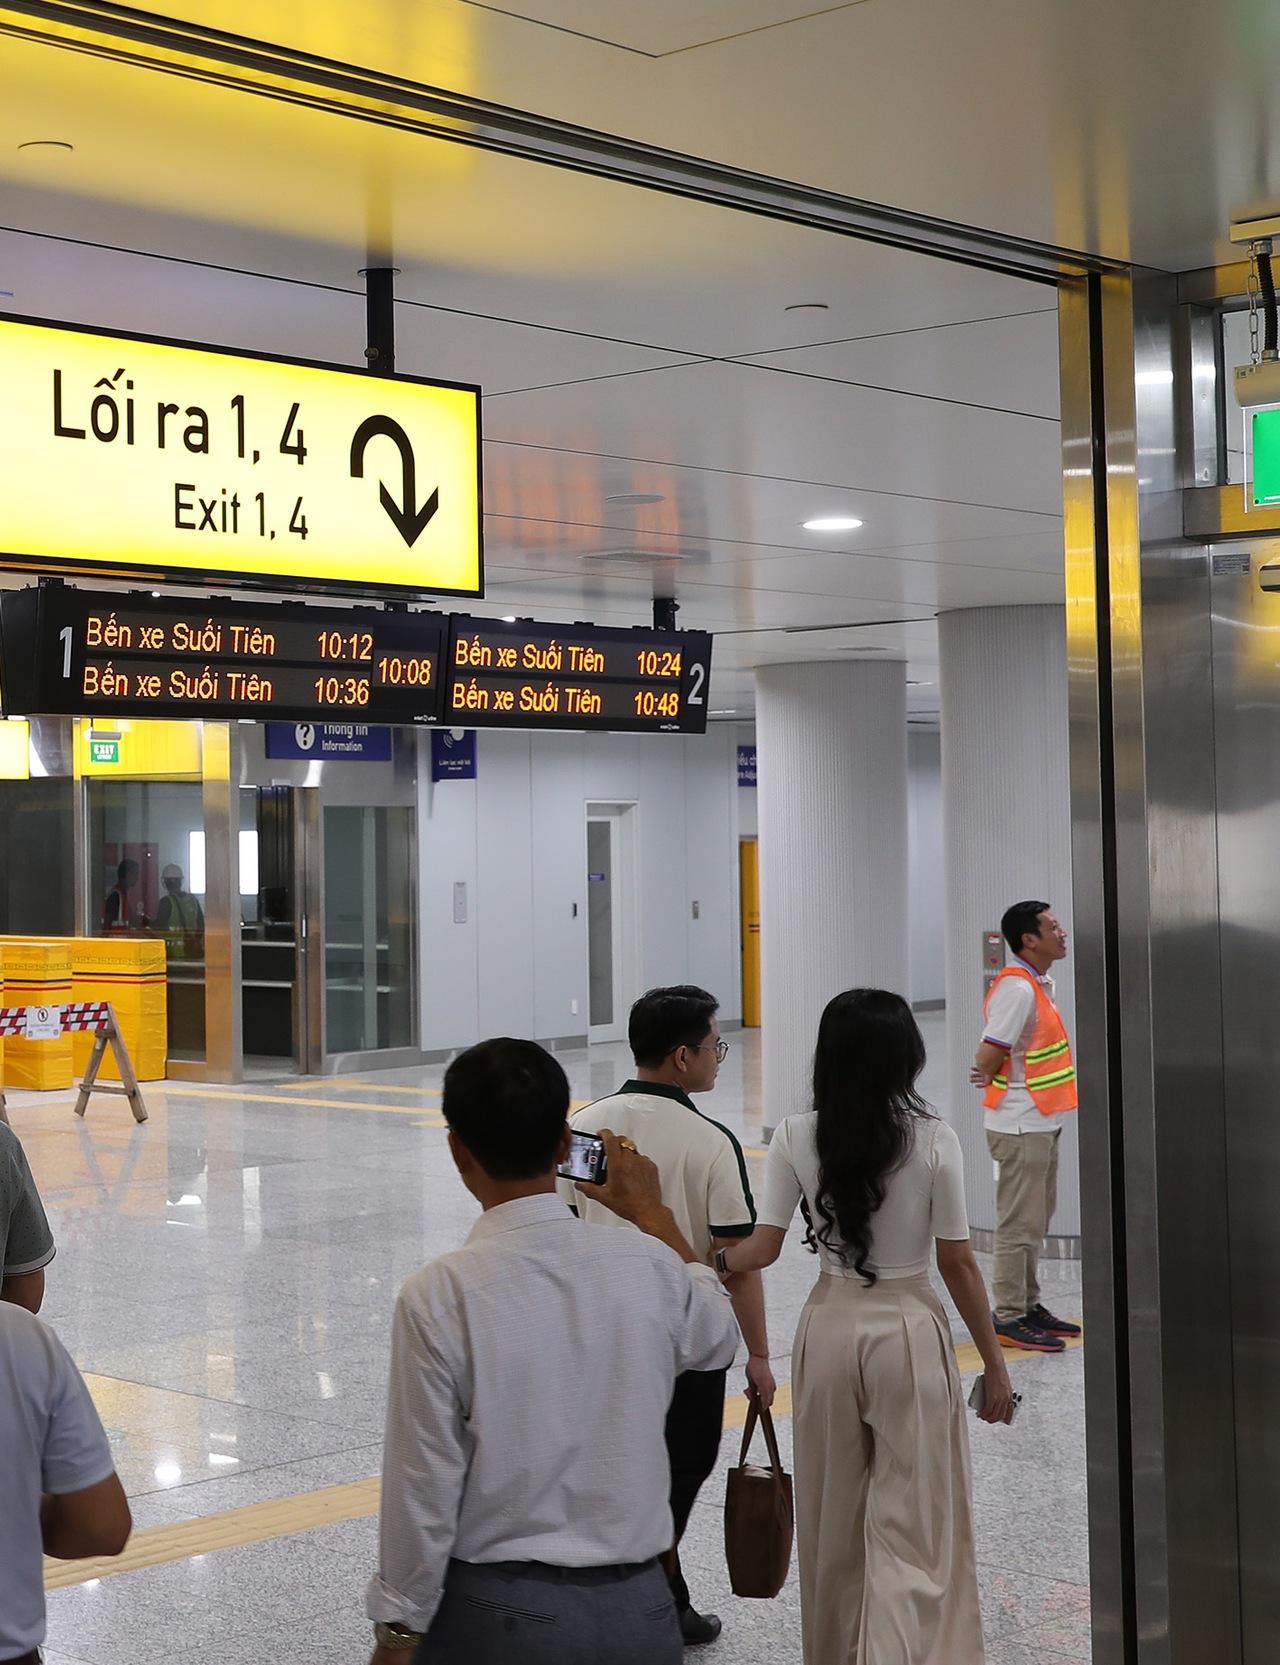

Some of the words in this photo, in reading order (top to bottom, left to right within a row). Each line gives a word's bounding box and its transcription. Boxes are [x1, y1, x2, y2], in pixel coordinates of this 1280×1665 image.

[53, 367, 135, 446] Lối
[157, 402, 209, 455] ra
[231, 394, 260, 465] 1,
[279, 402, 308, 466] 4
[174, 482, 240, 534] Exit
[255, 492, 276, 541] 1,
[287, 496, 309, 540] 4
[59, 626, 73, 678] 1
[86, 612, 132, 648] Bến
[138, 627, 165, 649] xe
[171, 618, 222, 652] Suối
[229, 625, 275, 655] Tiên
[318, 631, 373, 660] 10:12
[455, 634, 492, 667] Bến
[496, 647, 518, 668] xe
[522, 640, 563, 670] Suối
[567, 646, 605, 673] Tiên
[637, 650, 682, 677] 10:24
[83, 661, 129, 696] Bến
[135, 675, 162, 697] xe
[168, 665, 219, 699] Suối
[226, 673, 272, 702] Tiên
[314, 677, 370, 705] 10:36
[378, 657, 432, 685] 10:08
[687, 662, 705, 705] 2
[452, 677, 489, 710] Bến
[492, 690, 515, 711] xe
[519, 681, 560, 712] Suối
[564, 688, 602, 714] Tiên
[634, 691, 679, 717] 10:48
[93, 744, 115, 755] EXIT
[321, 740, 363, 752] Information
